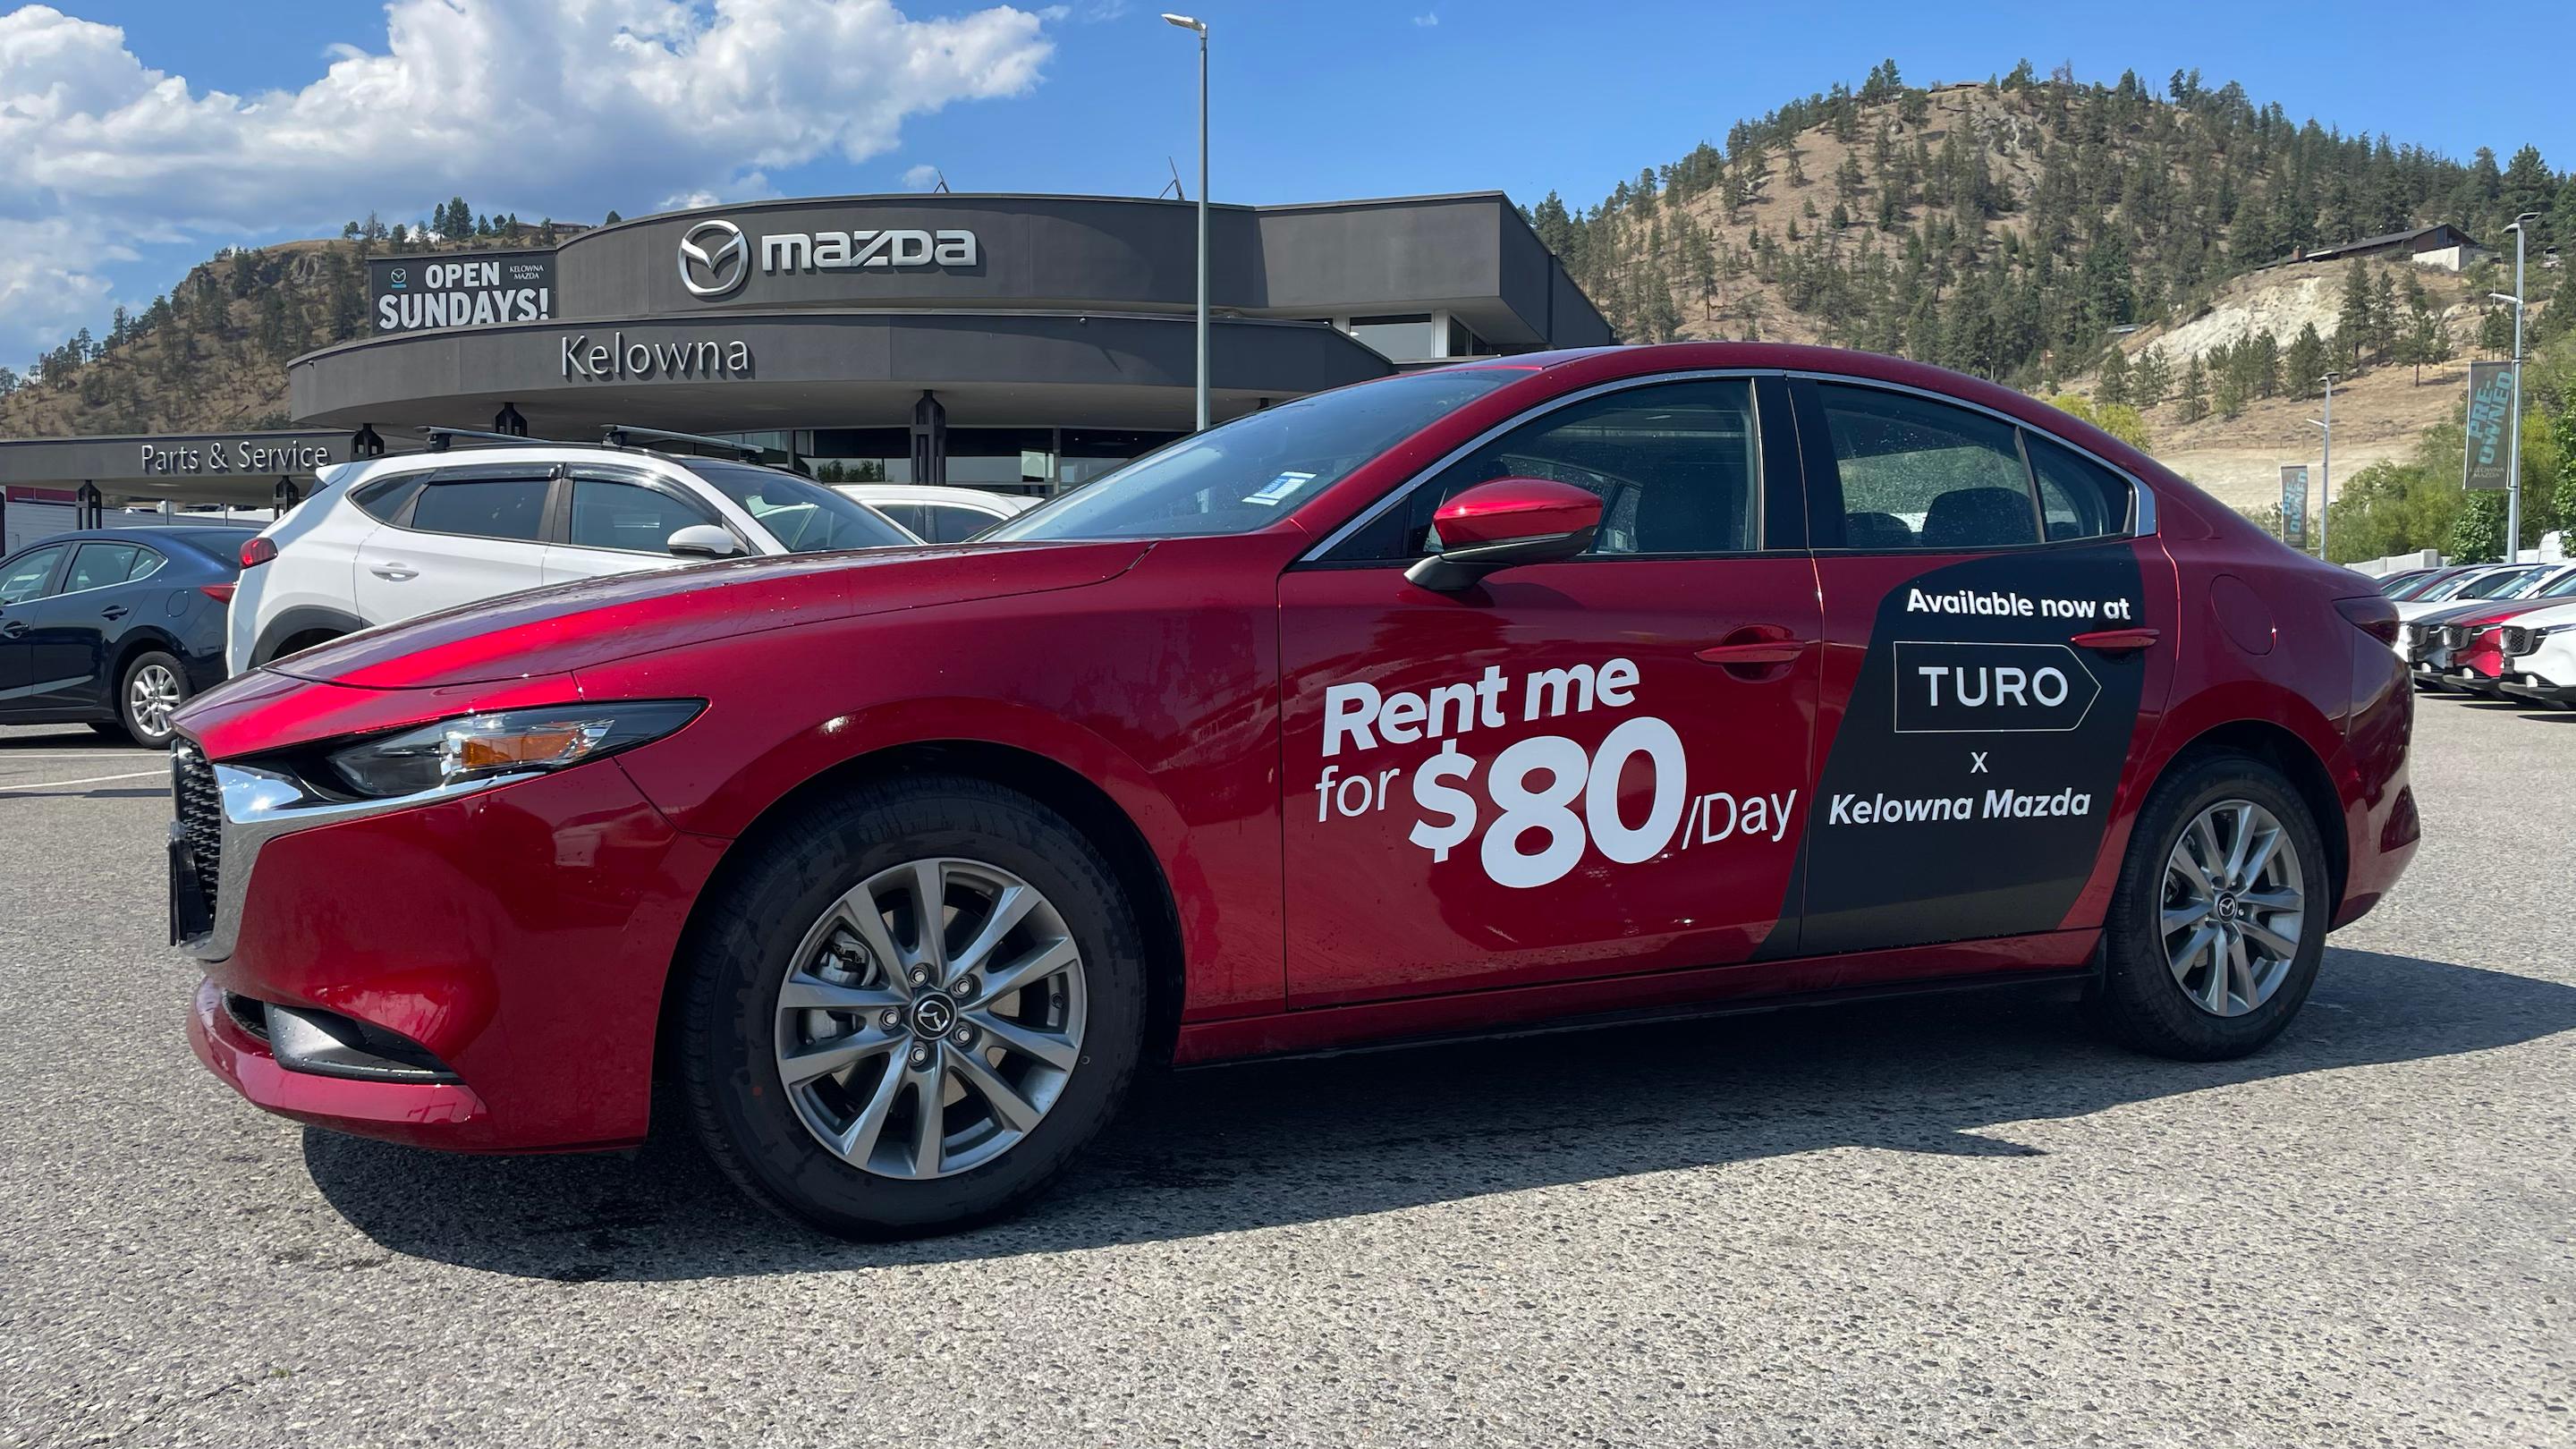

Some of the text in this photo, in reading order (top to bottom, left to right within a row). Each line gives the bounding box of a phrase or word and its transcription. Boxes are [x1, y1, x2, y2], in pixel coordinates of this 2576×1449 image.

[425, 261, 500, 289] OPEN
[509, 265, 544, 273] KELOWNA
[513, 272, 540, 280] MAZDA
[378, 287, 549, 330] SUNDAYS!
[561, 332, 750, 377] Kelowna
[2478, 371, 2513, 465] OWNED
[141, 440, 328, 470] Parts & Service
[1906, 588, 2131, 621] Available now at
[1321, 657, 1640, 757] Rent me
[1918, 666, 2069, 708] TURO
[1315, 765, 1401, 823] for
[1828, 786, 2092, 826] Kelowna Mazda
